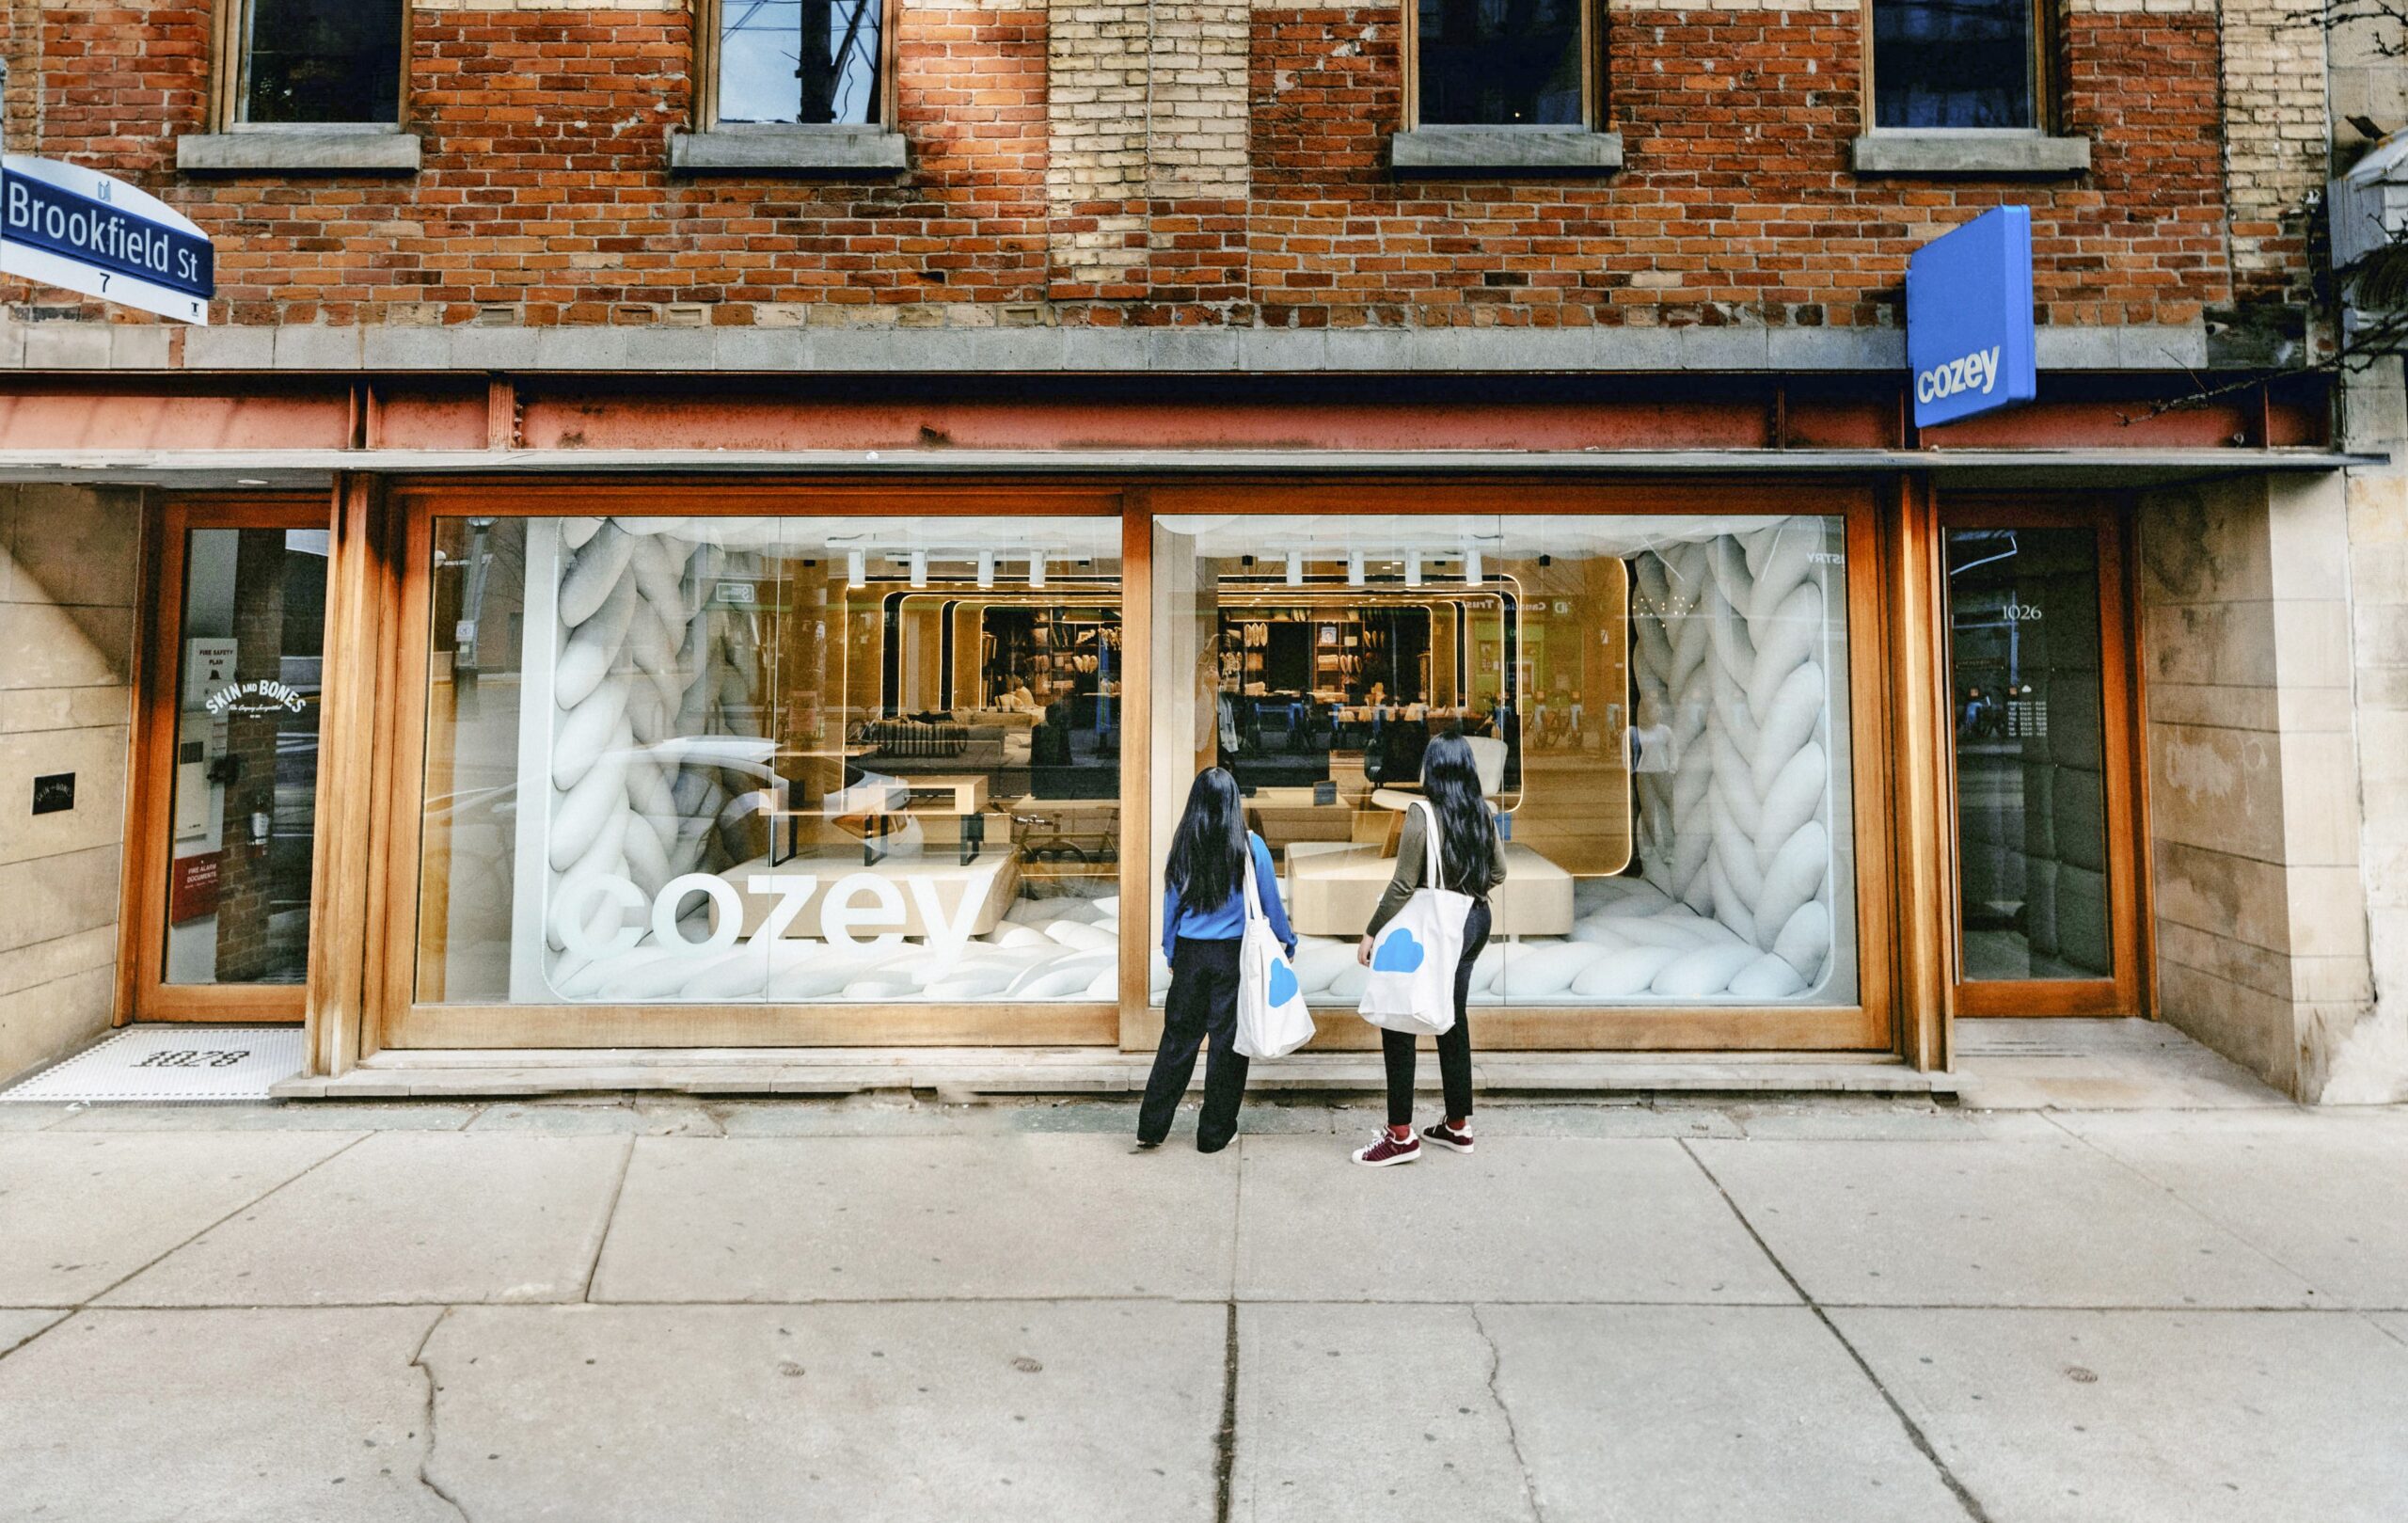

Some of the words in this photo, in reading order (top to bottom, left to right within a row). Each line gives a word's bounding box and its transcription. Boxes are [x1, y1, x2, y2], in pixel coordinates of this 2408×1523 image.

[8, 182, 169, 274] Brookfield
[178, 248, 198, 282] St
[99, 272, 111, 293] 7
[1917, 345, 2001, 405] cozey
[2003, 604, 2042, 620] 1026
[205, 683, 243, 714] SKIN
[242, 683, 258, 694] AND
[259, 679, 307, 713] BONES
[188, 866, 199, 875] FIRE
[199, 863, 217, 873] ALARM
[557, 872, 996, 985] cozey
[130, 1050, 250, 1068] 1028
